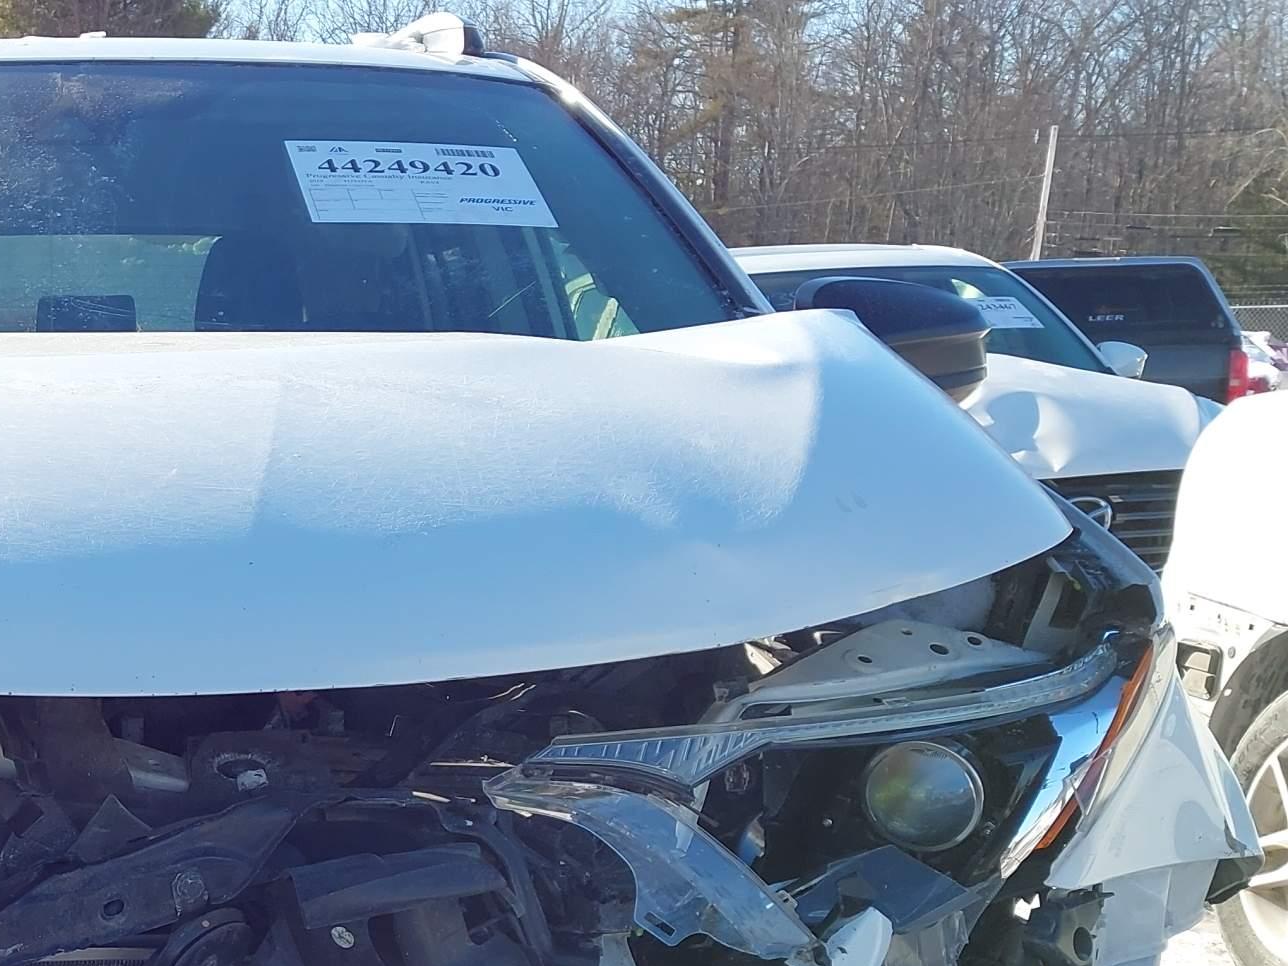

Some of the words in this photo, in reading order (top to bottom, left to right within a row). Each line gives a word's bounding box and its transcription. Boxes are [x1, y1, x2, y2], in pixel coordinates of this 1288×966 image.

[317, 158, 501, 178] 44249420
[459, 196, 537, 206] PROGRESSIVE
[1088, 314, 1125, 322] LEER
